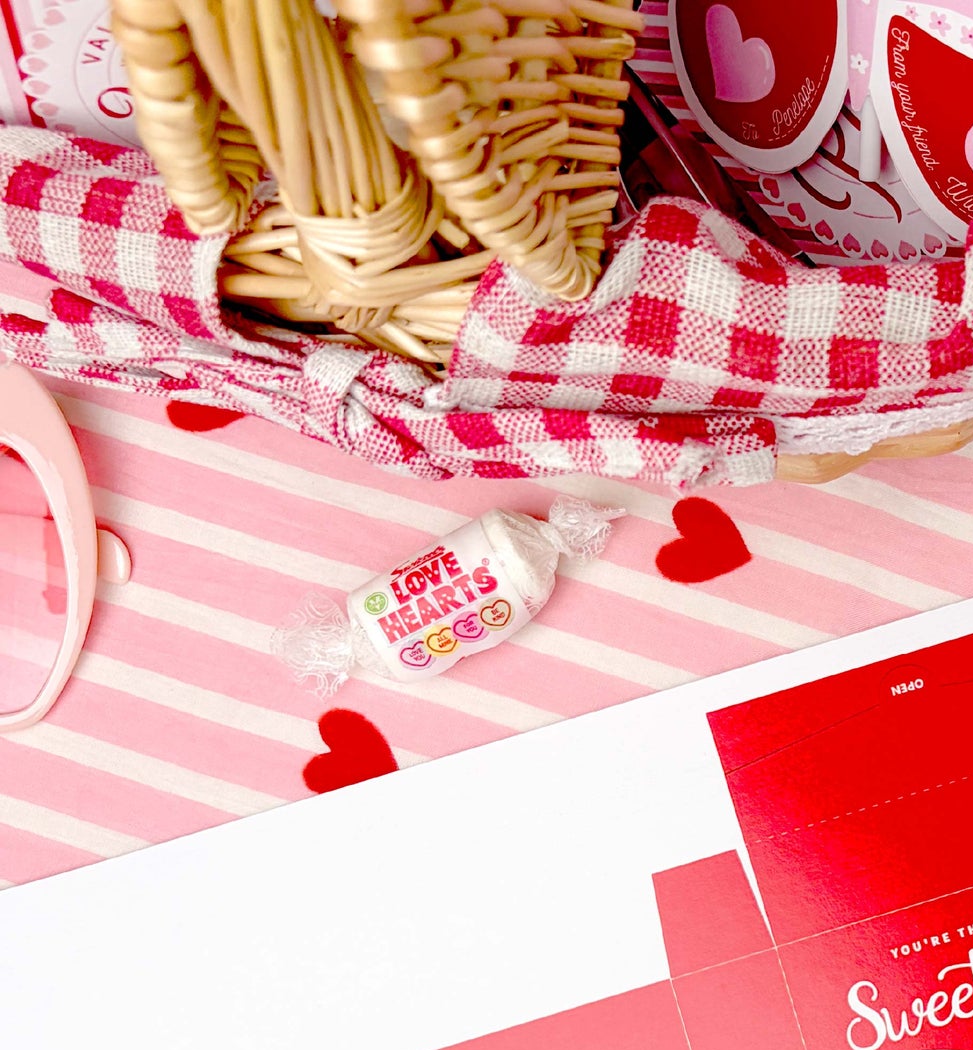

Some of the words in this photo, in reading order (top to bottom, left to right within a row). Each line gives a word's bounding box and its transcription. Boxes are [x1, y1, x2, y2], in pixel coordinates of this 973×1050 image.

[891, 27, 910, 79] From
[890, 81, 917, 121] your
[390, 551, 463, 605] LOVE
[377, 566, 498, 645] HEARTS
[890, 678, 924, 697] OPEN
[890, 932, 951, 959] YOU'RE
